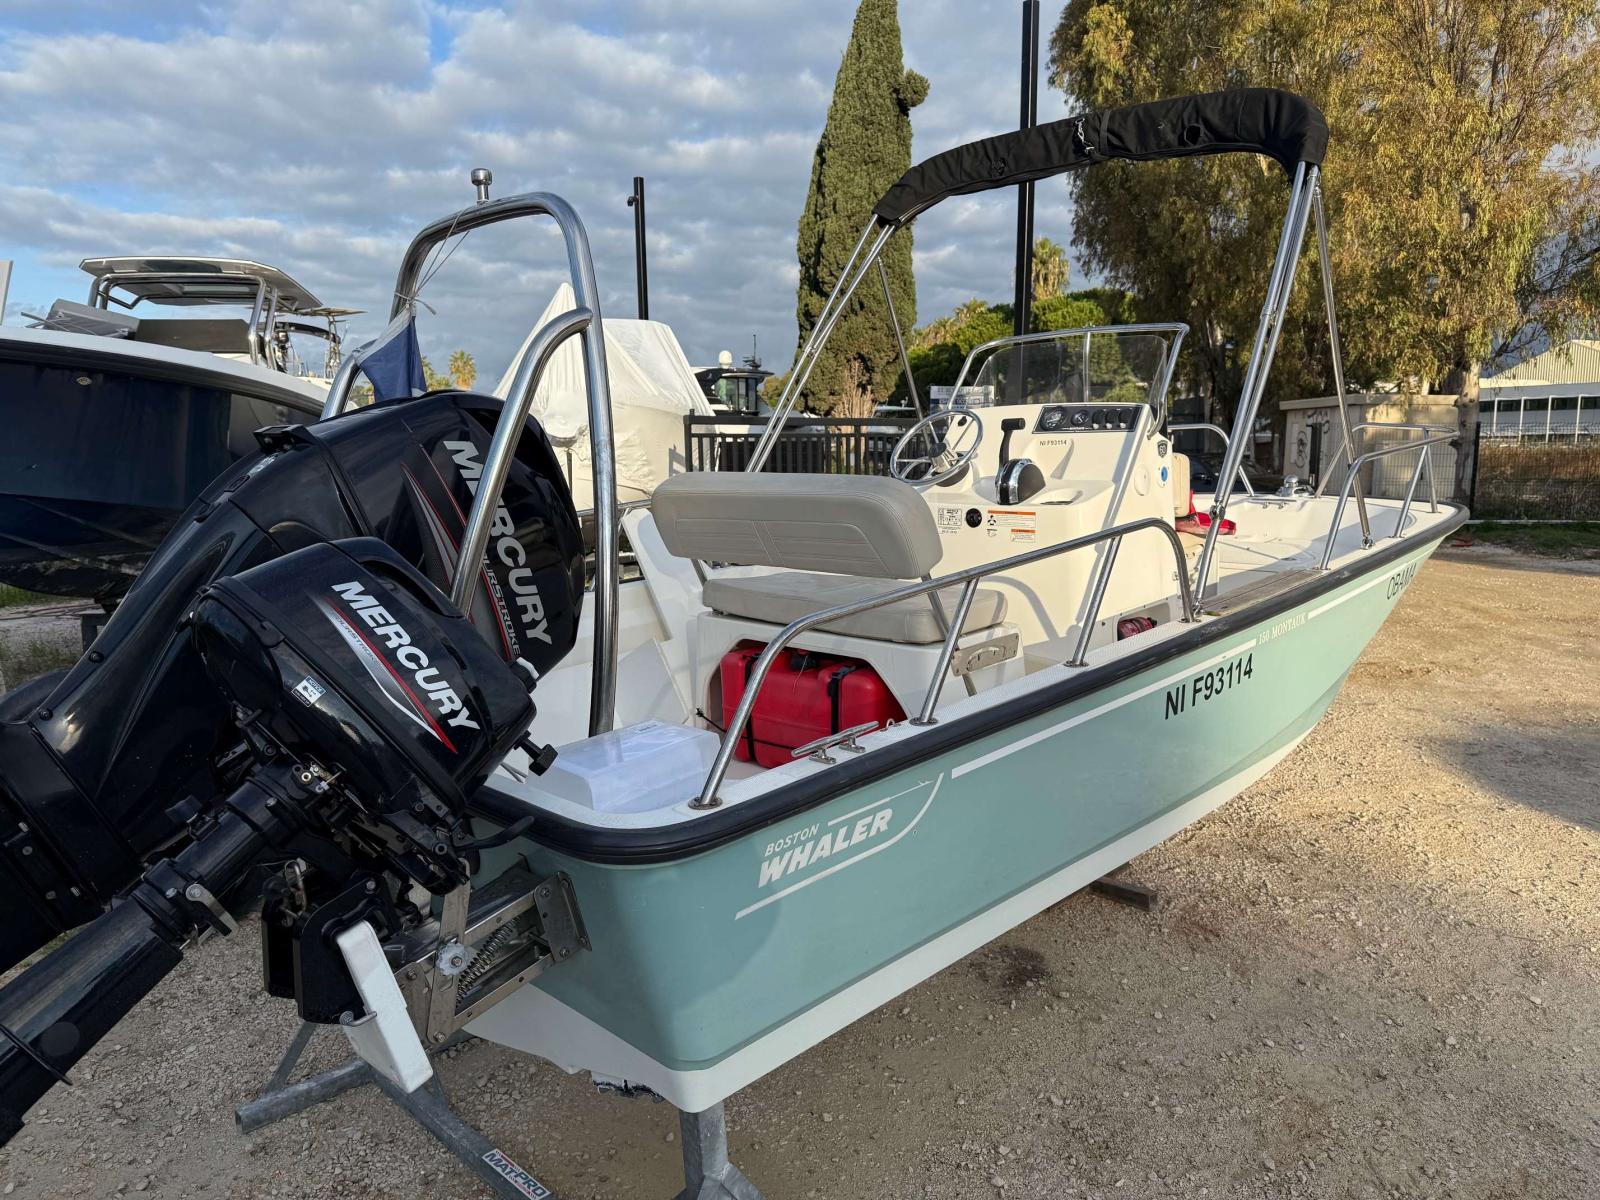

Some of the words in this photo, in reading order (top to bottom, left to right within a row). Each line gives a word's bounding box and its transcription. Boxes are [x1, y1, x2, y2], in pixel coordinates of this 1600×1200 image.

[443, 440, 552, 645] MRCURY
[483, 551, 521, 656] URSTROKE
[1258, 631, 1271, 645] 150
[1271, 612, 1306, 638] MONTAUK
[331, 581, 481, 730] MERCURY
[1165, 684, 1186, 720] NI
[1191, 653, 1253, 707] F93114
[758, 808, 893, 888] WHALER
[764, 823, 819, 857] BOSTON
